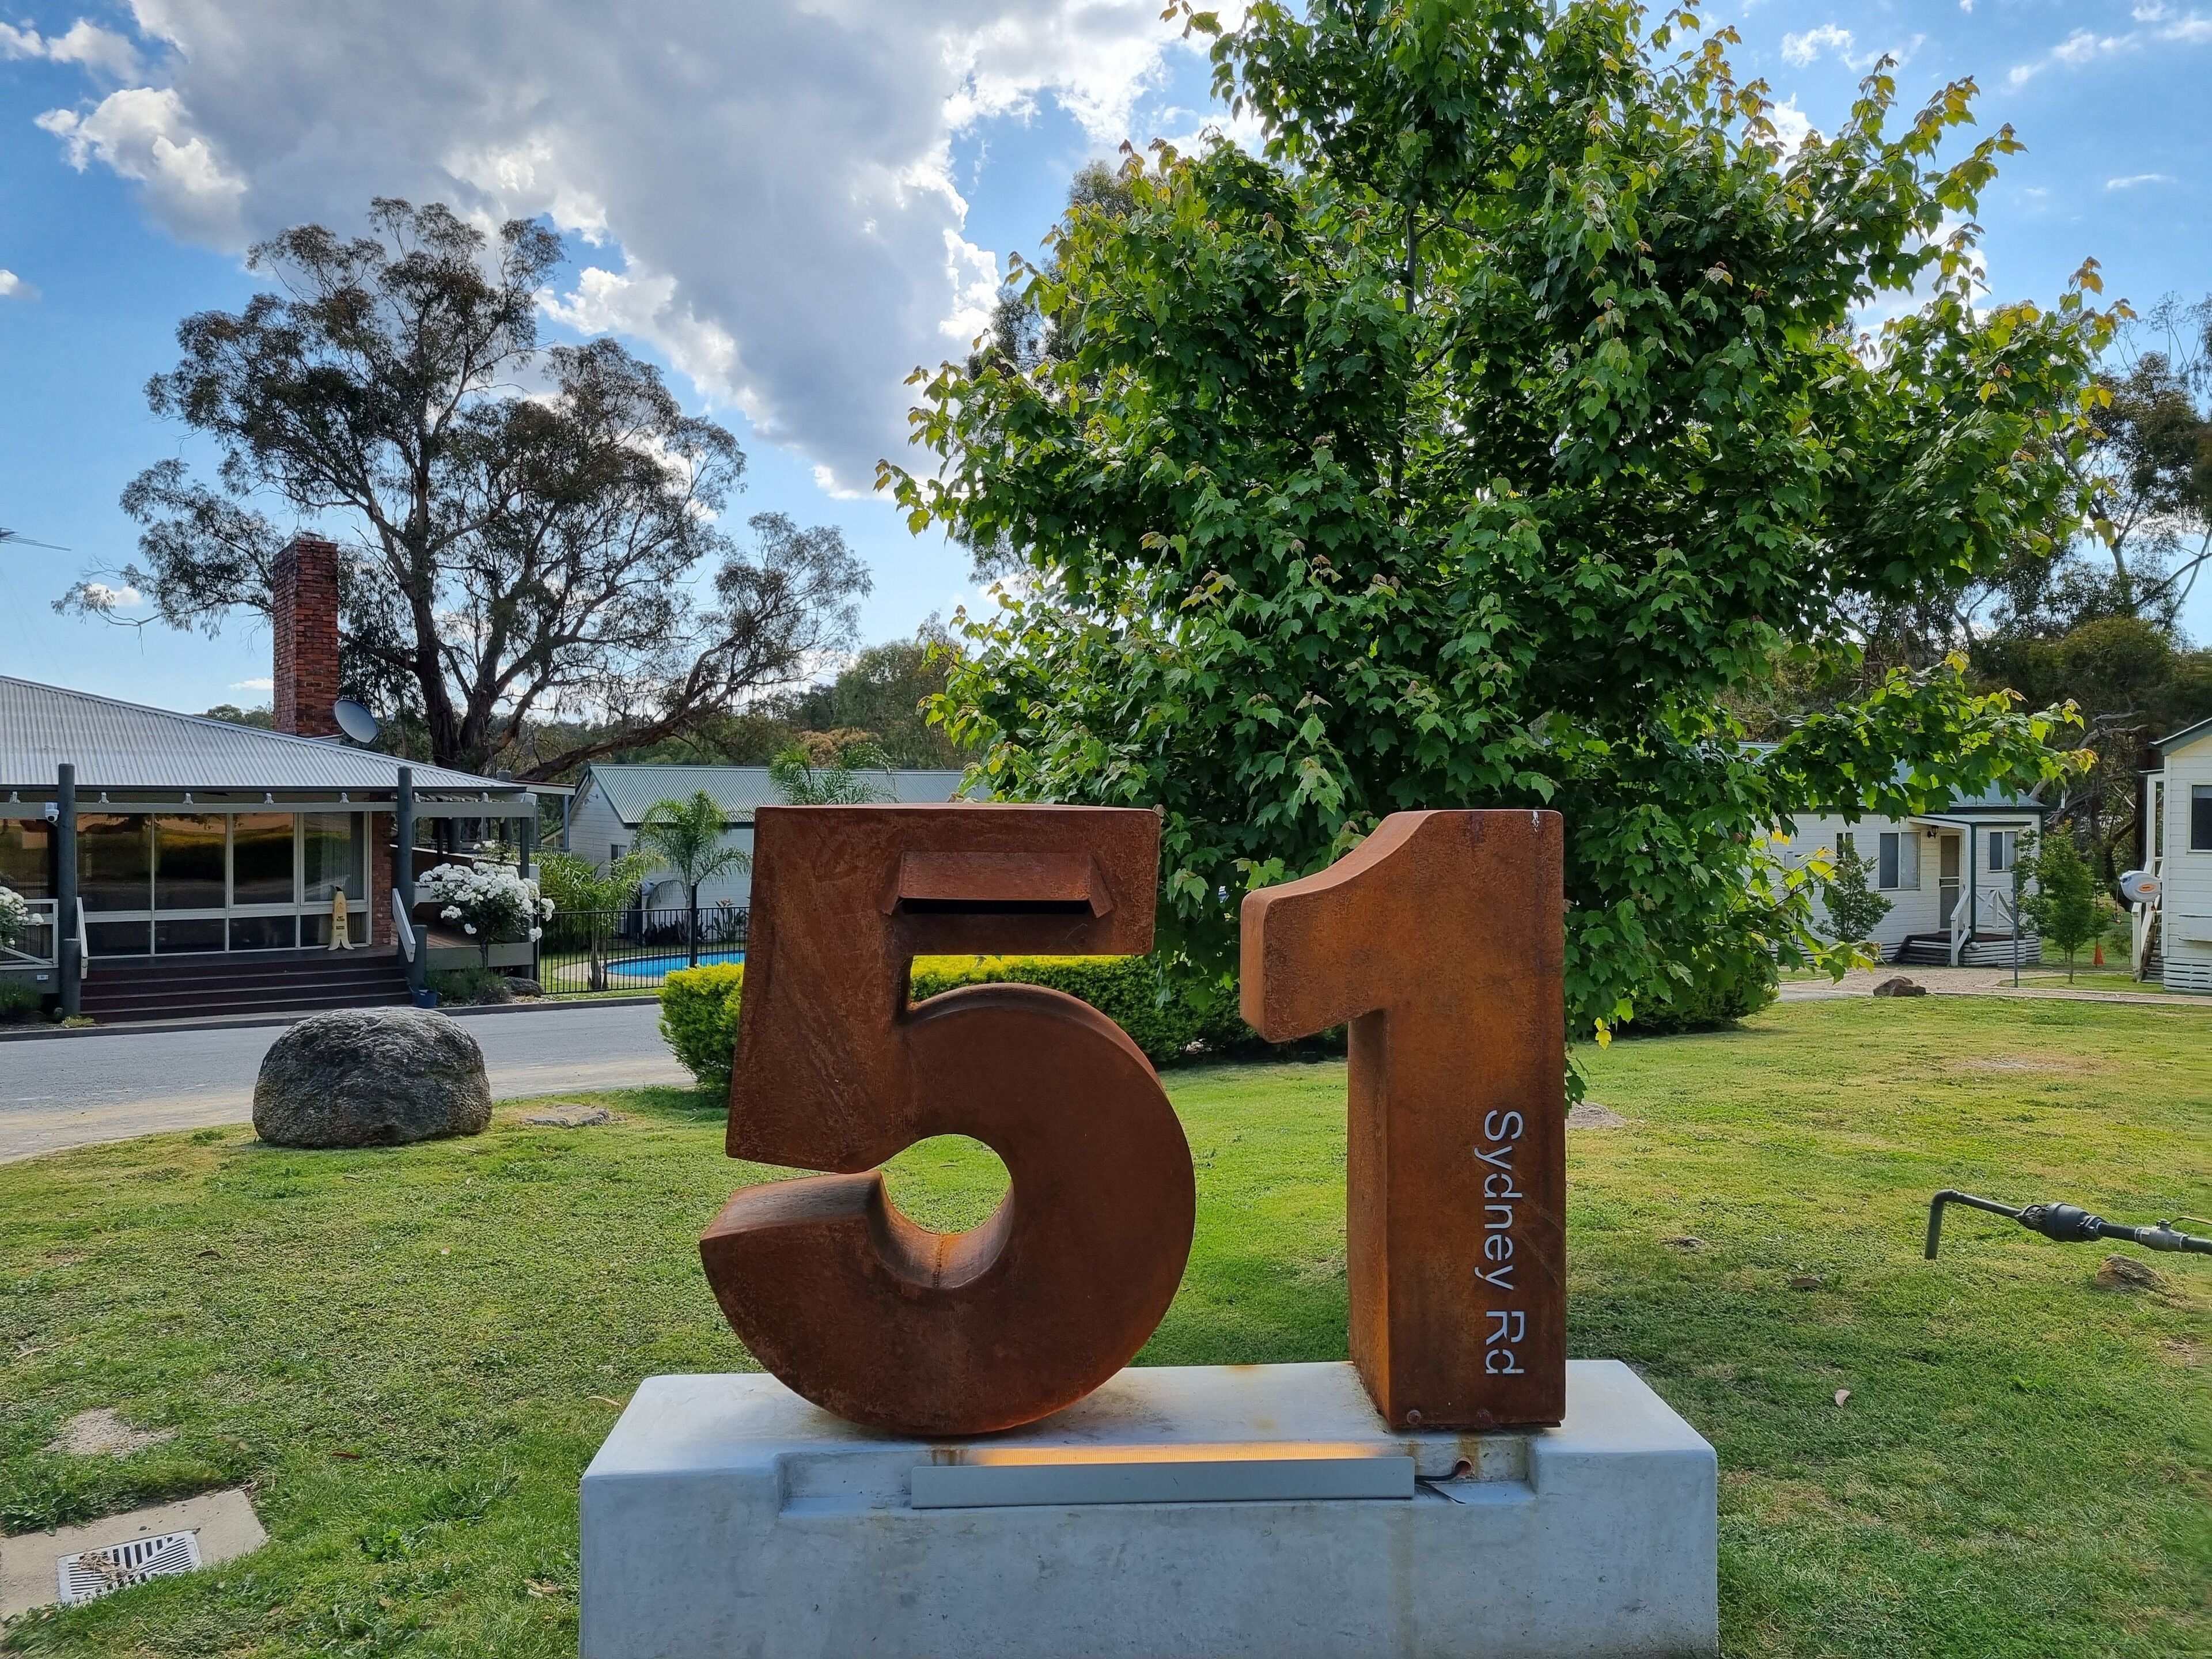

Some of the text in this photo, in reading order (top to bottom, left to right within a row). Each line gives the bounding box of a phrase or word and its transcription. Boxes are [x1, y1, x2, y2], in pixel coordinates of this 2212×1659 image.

[700, 804, 1566, 1436] 51
[1474, 1109, 1525, 1374] Sydney Rd
